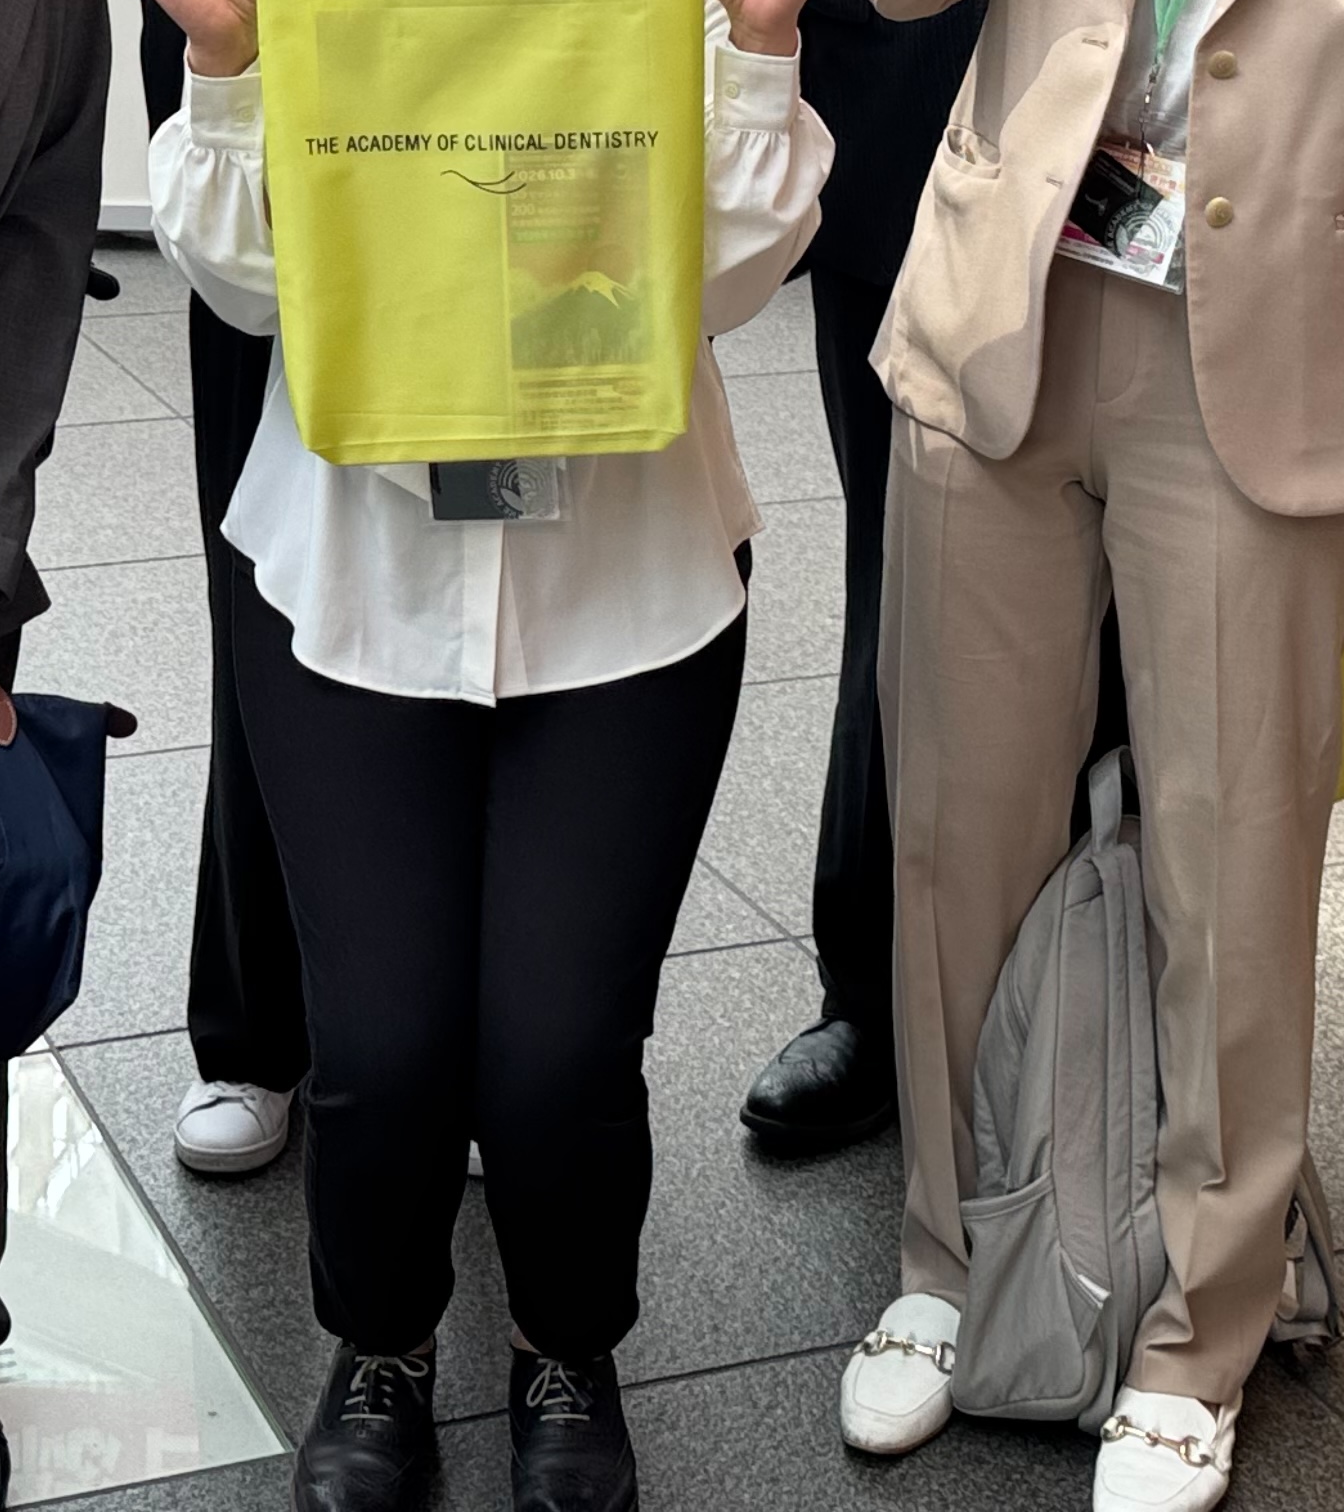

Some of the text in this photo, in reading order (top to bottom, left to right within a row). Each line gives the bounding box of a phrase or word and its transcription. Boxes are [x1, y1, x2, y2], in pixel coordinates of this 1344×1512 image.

[305, 130, 659, 155] THE ACADEMY OF CLINICAL DENTISTRY
